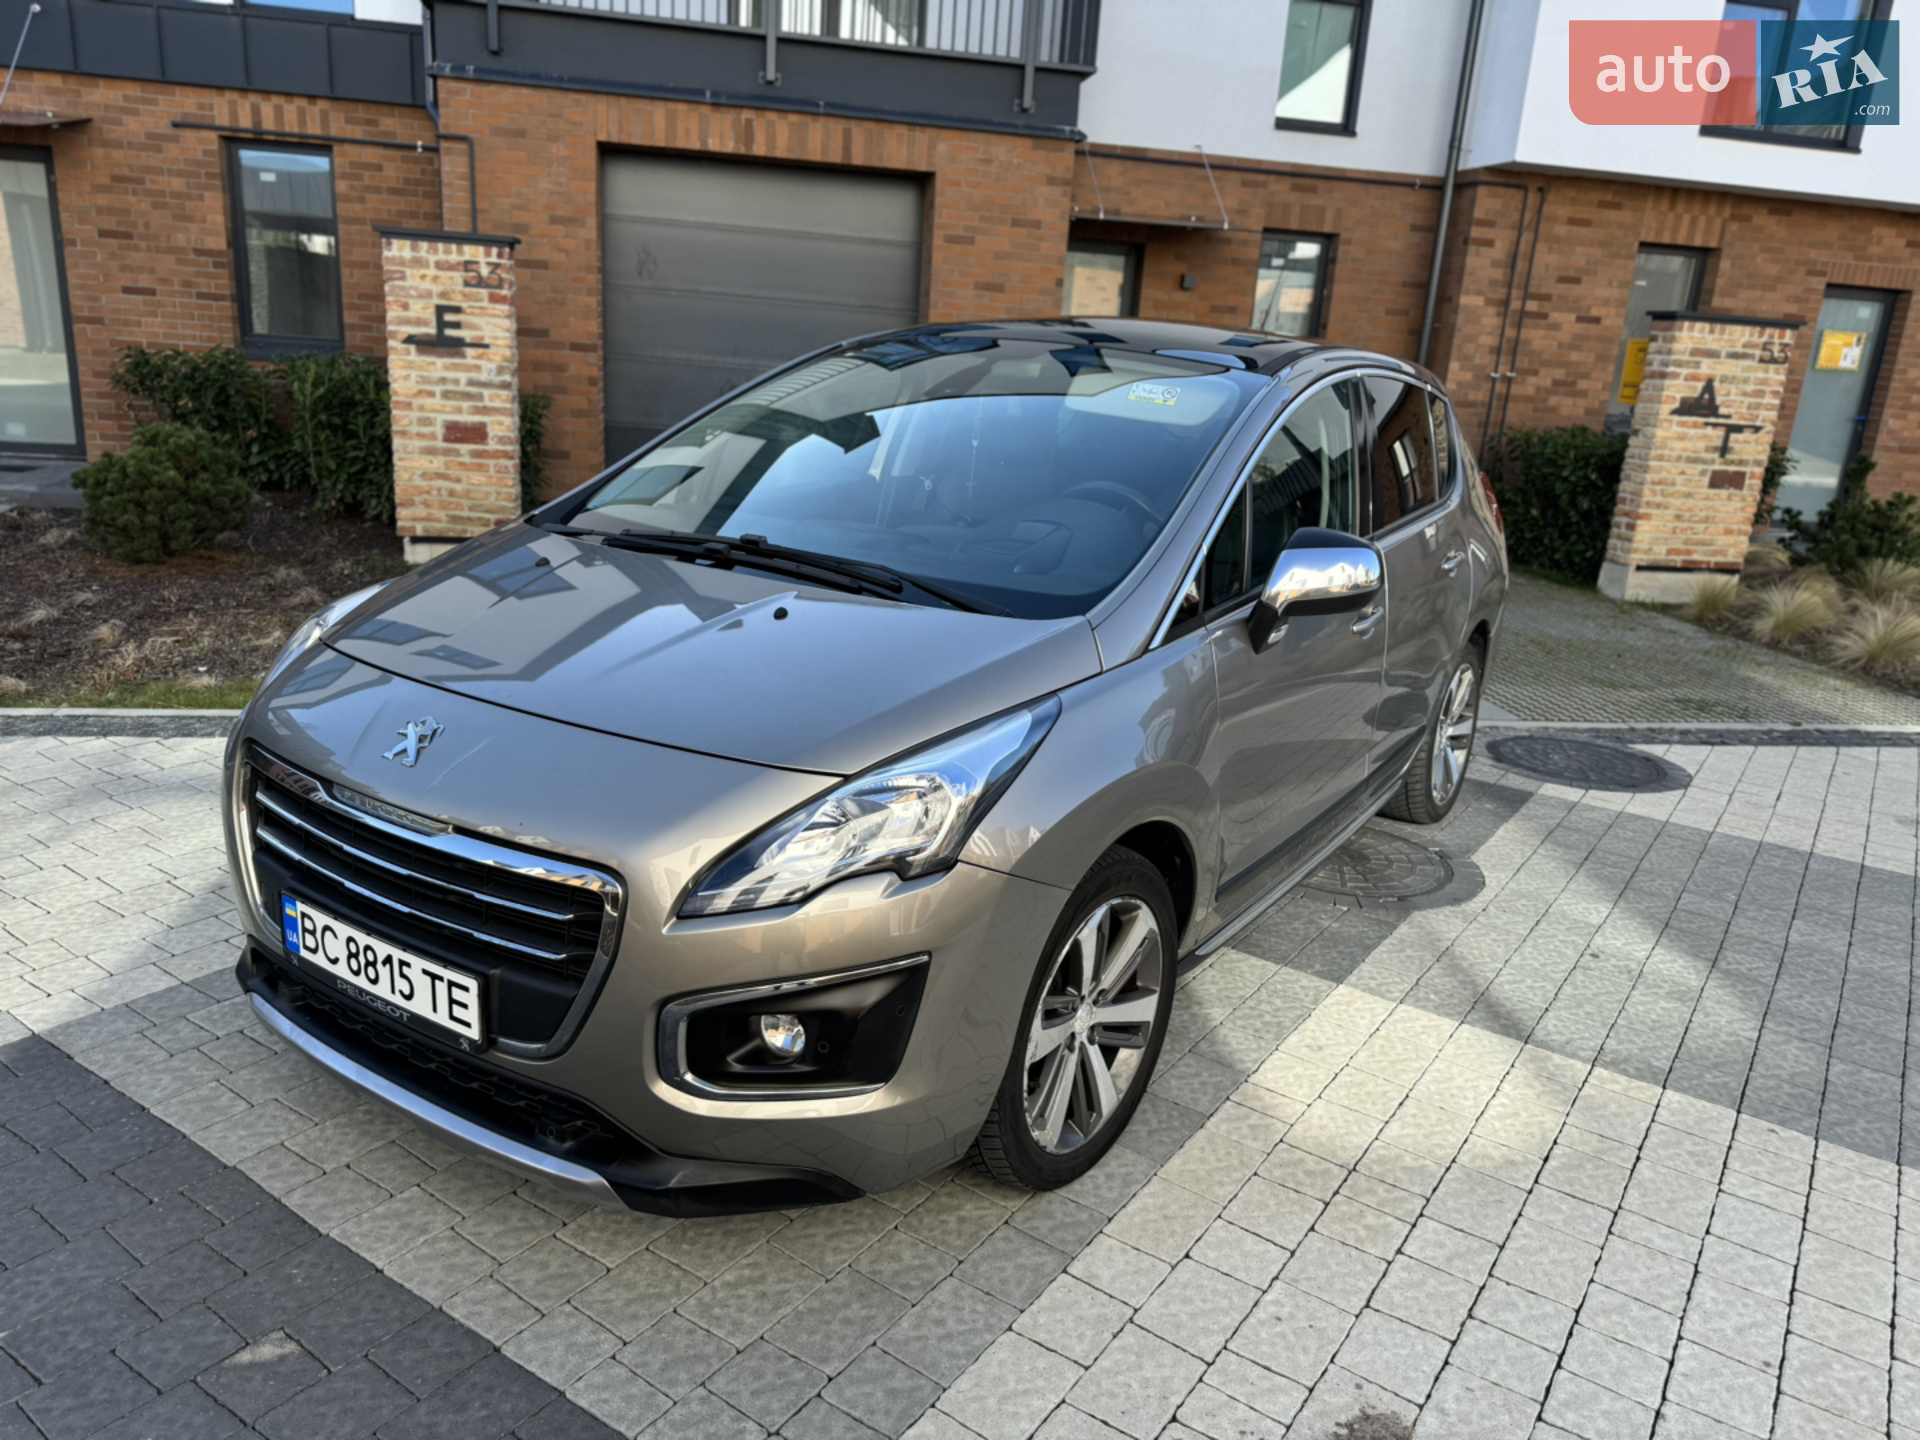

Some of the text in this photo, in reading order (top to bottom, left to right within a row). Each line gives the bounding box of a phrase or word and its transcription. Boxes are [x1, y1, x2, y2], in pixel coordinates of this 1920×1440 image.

[463, 260, 504, 290] 53
[1758, 341, 1792, 365] 53
[286, 928, 299, 945] UA
[300, 910, 473, 1029] BC 8815 TE
[336, 979, 411, 1022] PEUGEOT
